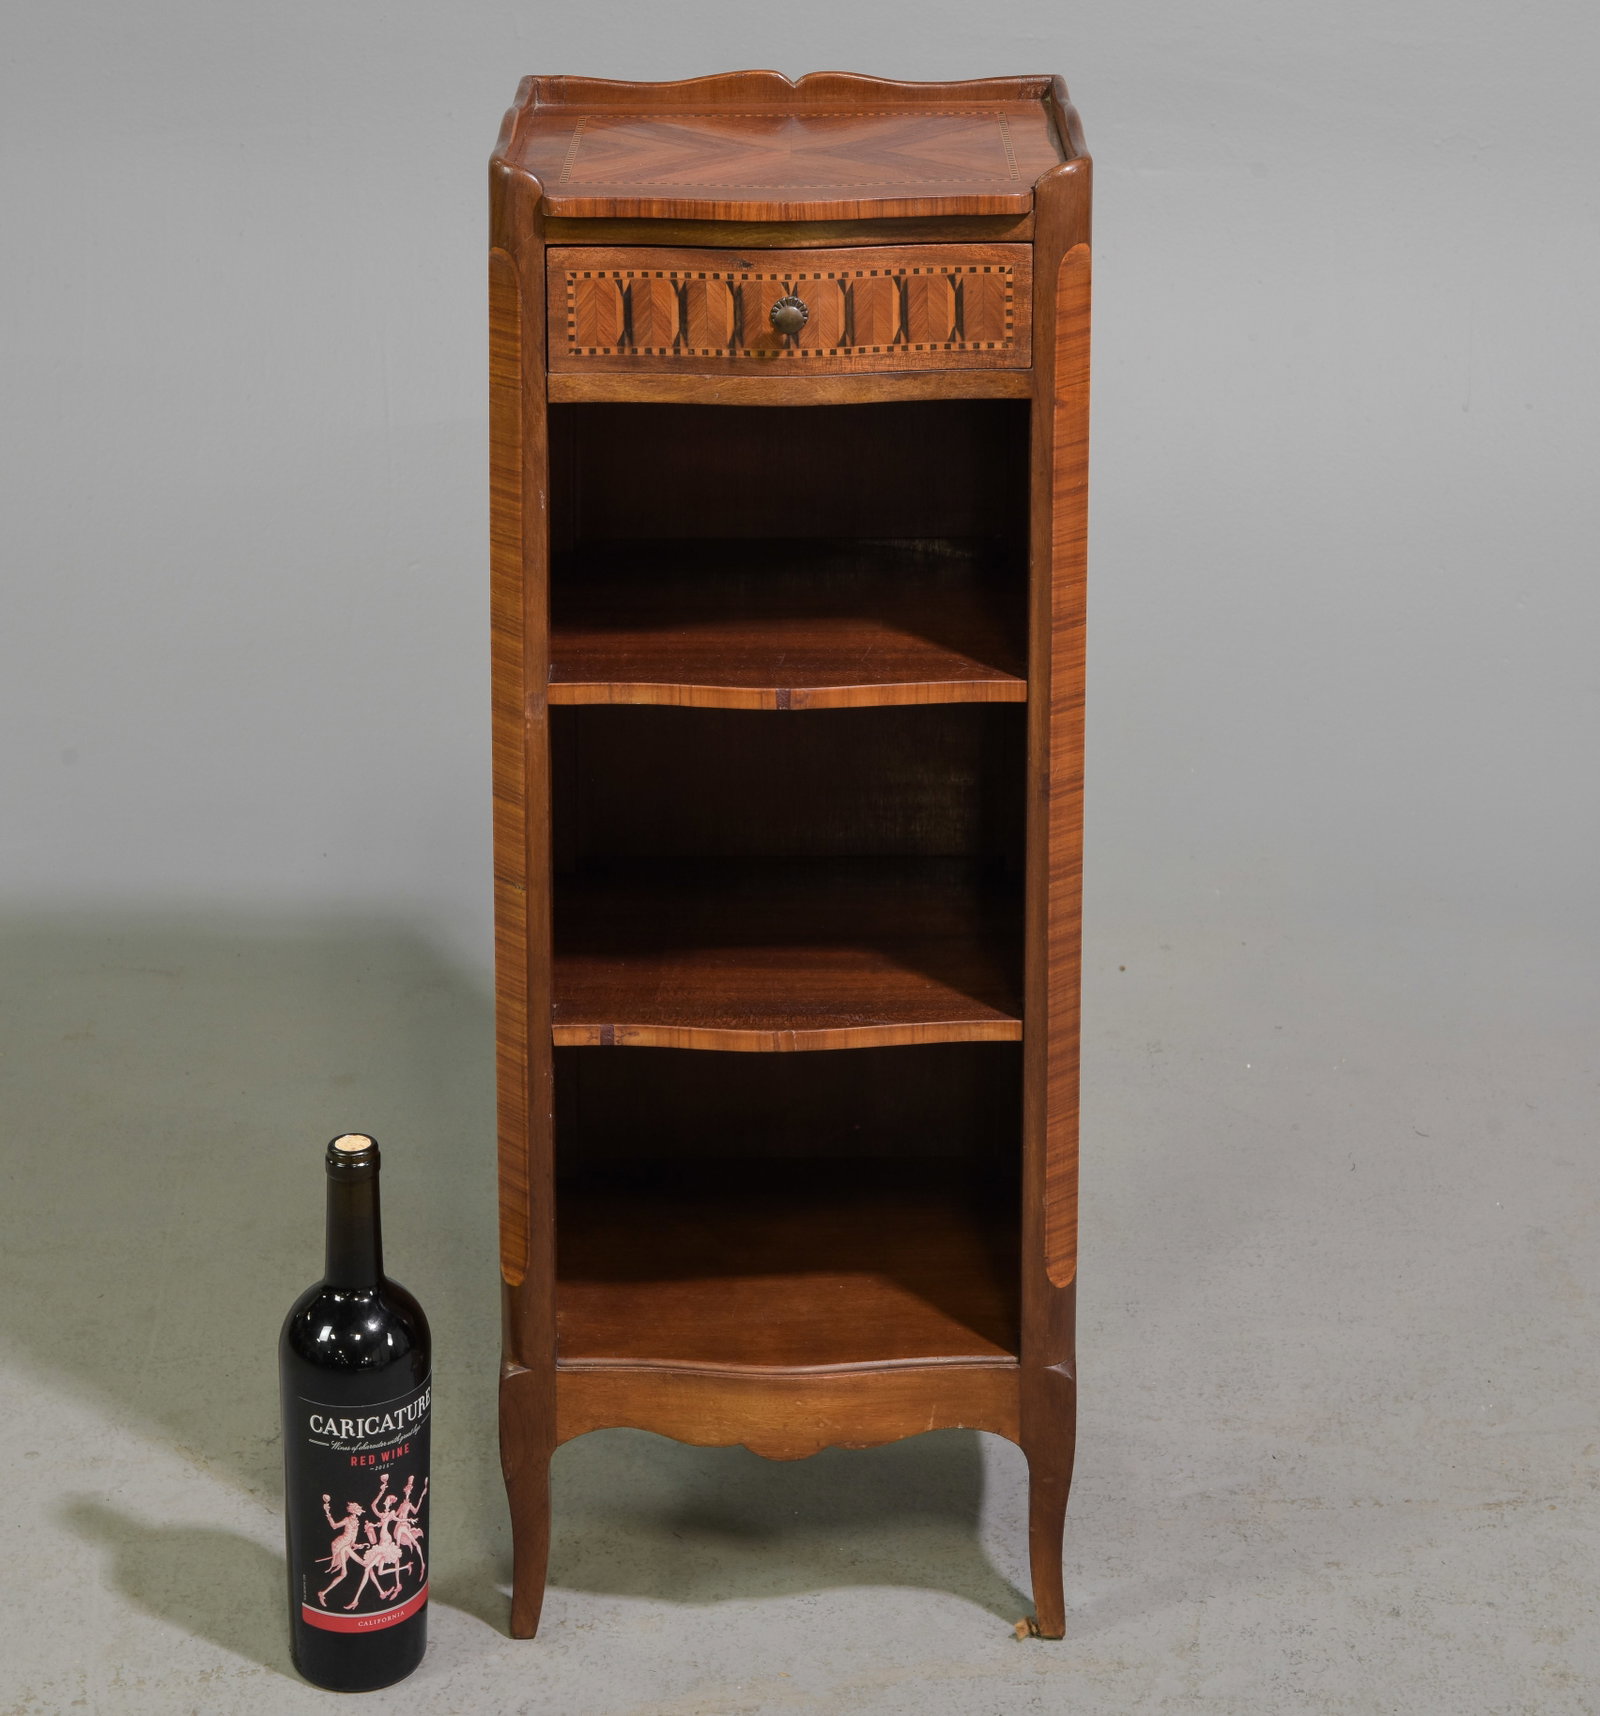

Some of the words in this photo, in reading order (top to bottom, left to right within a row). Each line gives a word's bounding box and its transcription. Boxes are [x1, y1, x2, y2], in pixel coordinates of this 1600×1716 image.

[309, 1386, 431, 1439] CARICATURE
[331, 1440, 351, 1451] Wines
[351, 1441, 362, 1454] of
[350, 1454, 376, 1467] RED
[381, 1442, 410, 1463] WINE
[358, 1610, 405, 1627] CALIFORNIA
